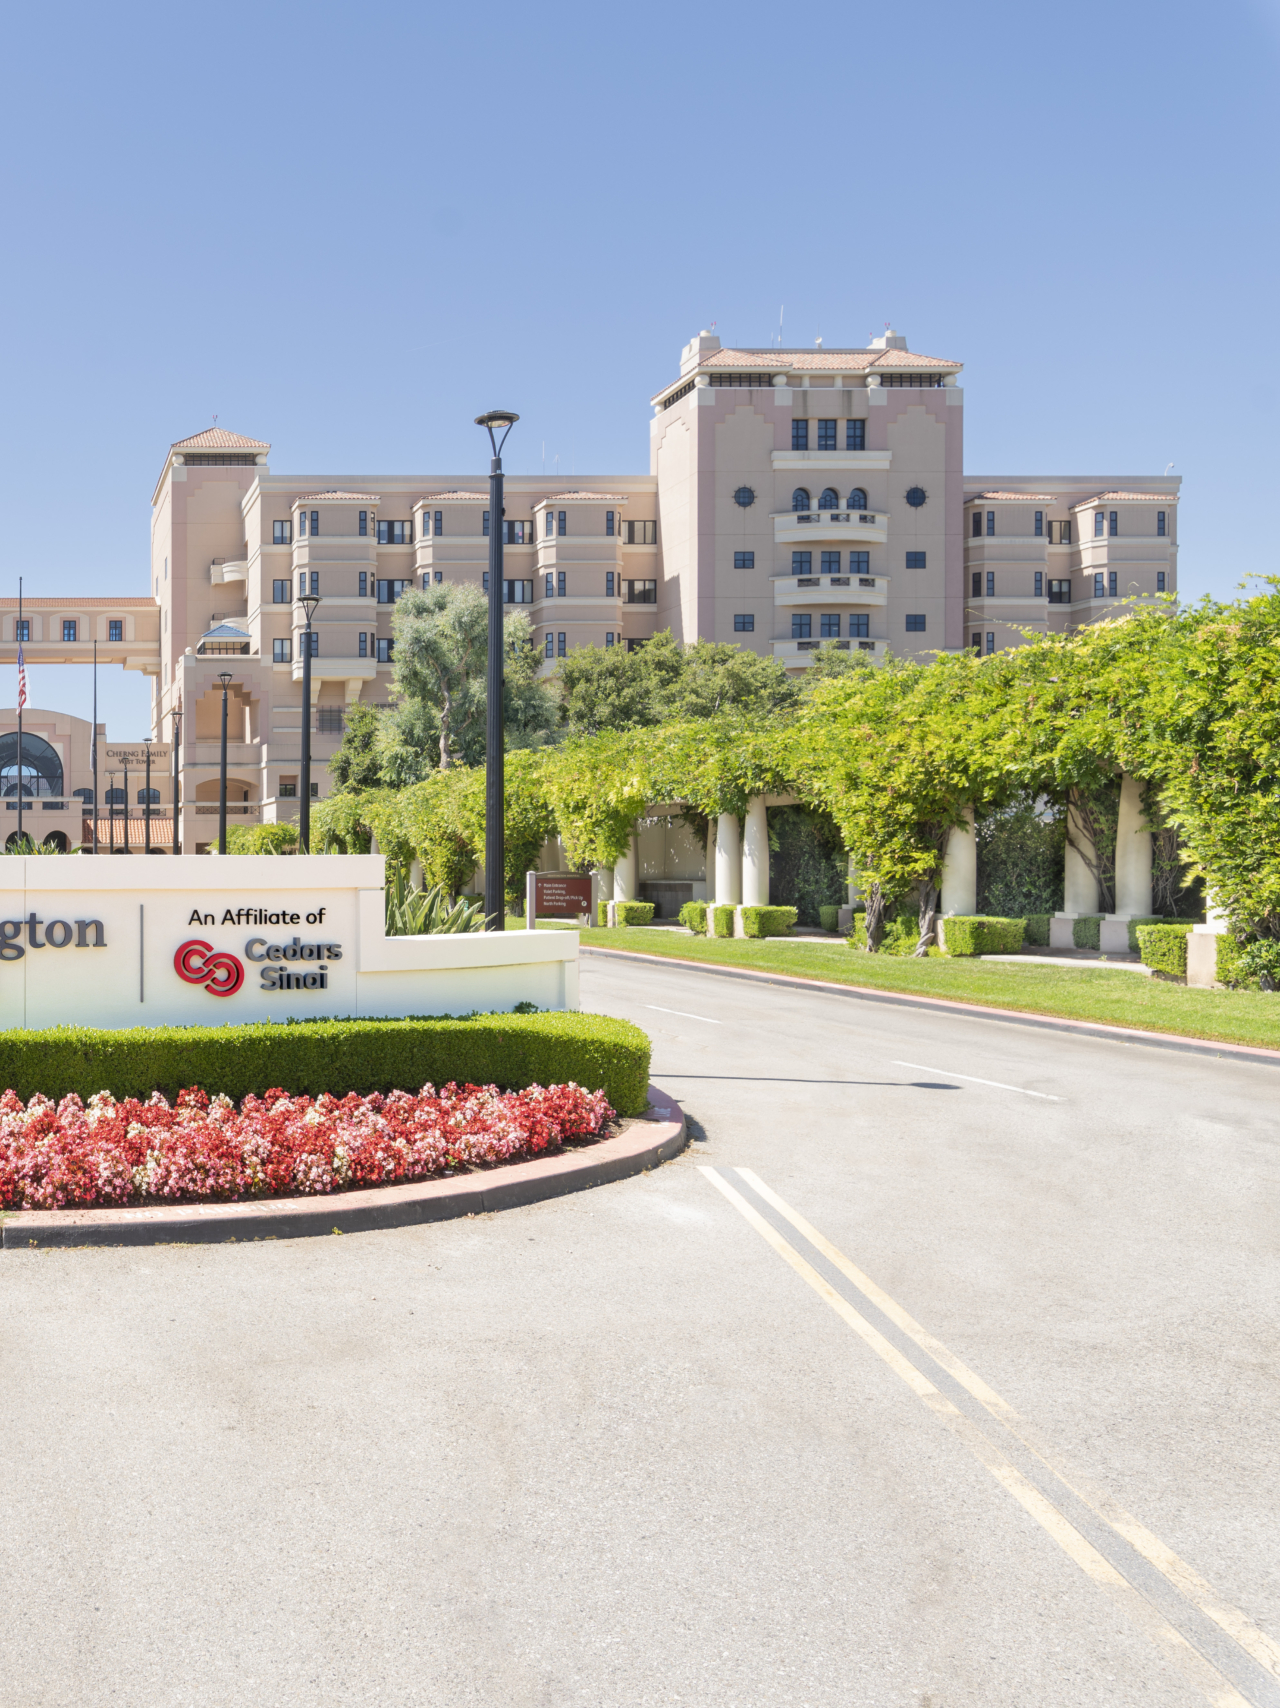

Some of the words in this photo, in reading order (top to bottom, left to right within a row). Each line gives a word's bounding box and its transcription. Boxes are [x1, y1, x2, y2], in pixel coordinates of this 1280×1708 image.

[188, 909, 215, 925] An
[221, 908, 301, 925] Affiliate
[305, 907, 326, 925] of
[245, 937, 343, 962] Cedars
[260, 965, 328, 991] Sinai
